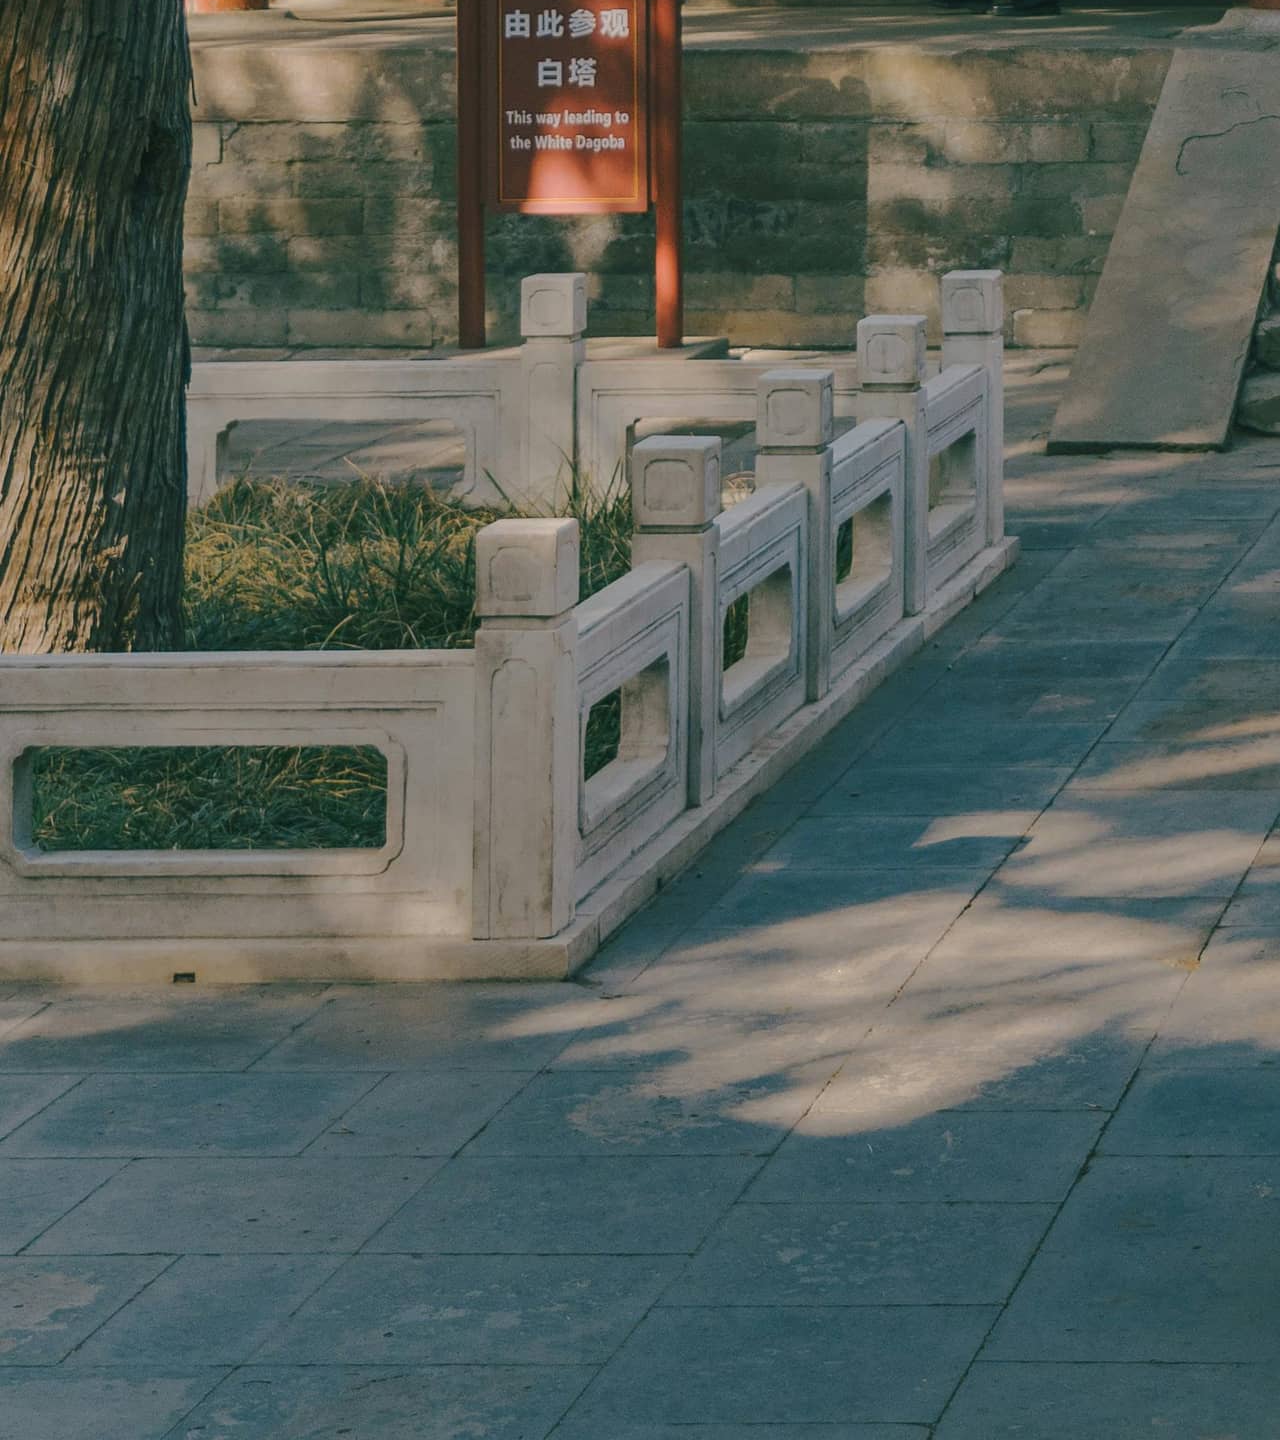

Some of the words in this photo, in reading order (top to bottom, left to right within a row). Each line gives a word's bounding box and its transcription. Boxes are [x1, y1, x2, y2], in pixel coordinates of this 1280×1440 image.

[504, 9, 629, 38] 由此参观
[537, 58, 596, 87] 白塔
[506, 111, 532, 125] This
[535, 113, 561, 128] way
[564, 110, 611, 128] leading
[615, 112, 629, 125] to
[510, 135, 531, 149] the
[534, 135, 573, 149] White
[576, 135, 625, 152] Dagoba
